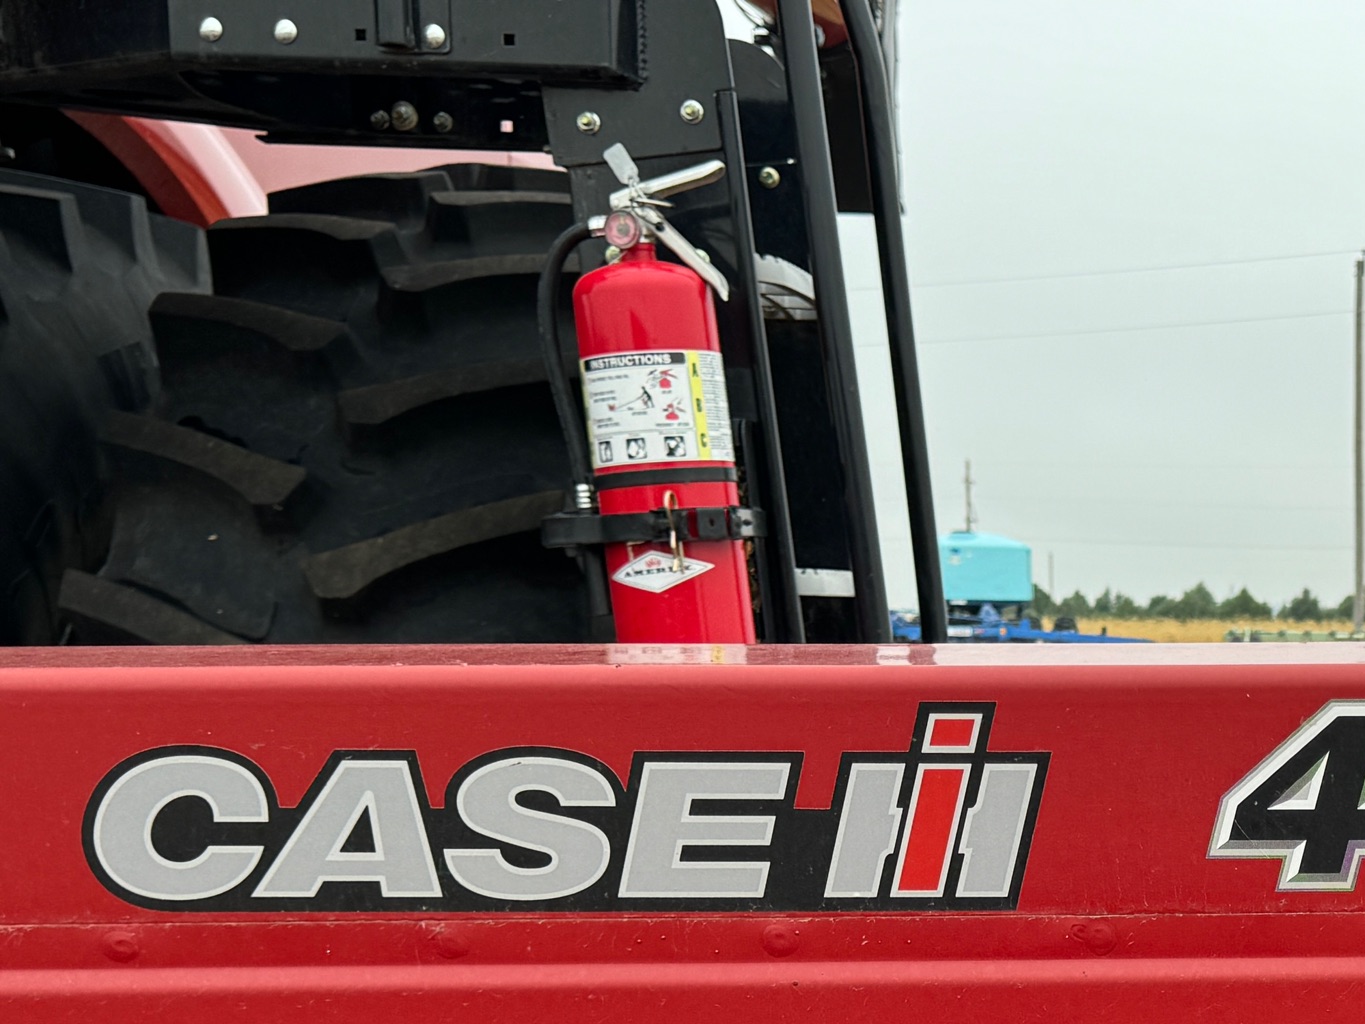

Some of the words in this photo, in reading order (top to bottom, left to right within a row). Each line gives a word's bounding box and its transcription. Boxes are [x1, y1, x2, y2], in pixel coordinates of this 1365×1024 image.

[590, 354, 672, 369] INSTRUCTIONS
[692, 363, 700, 377] A
[92, 755, 796, 901] CASE
